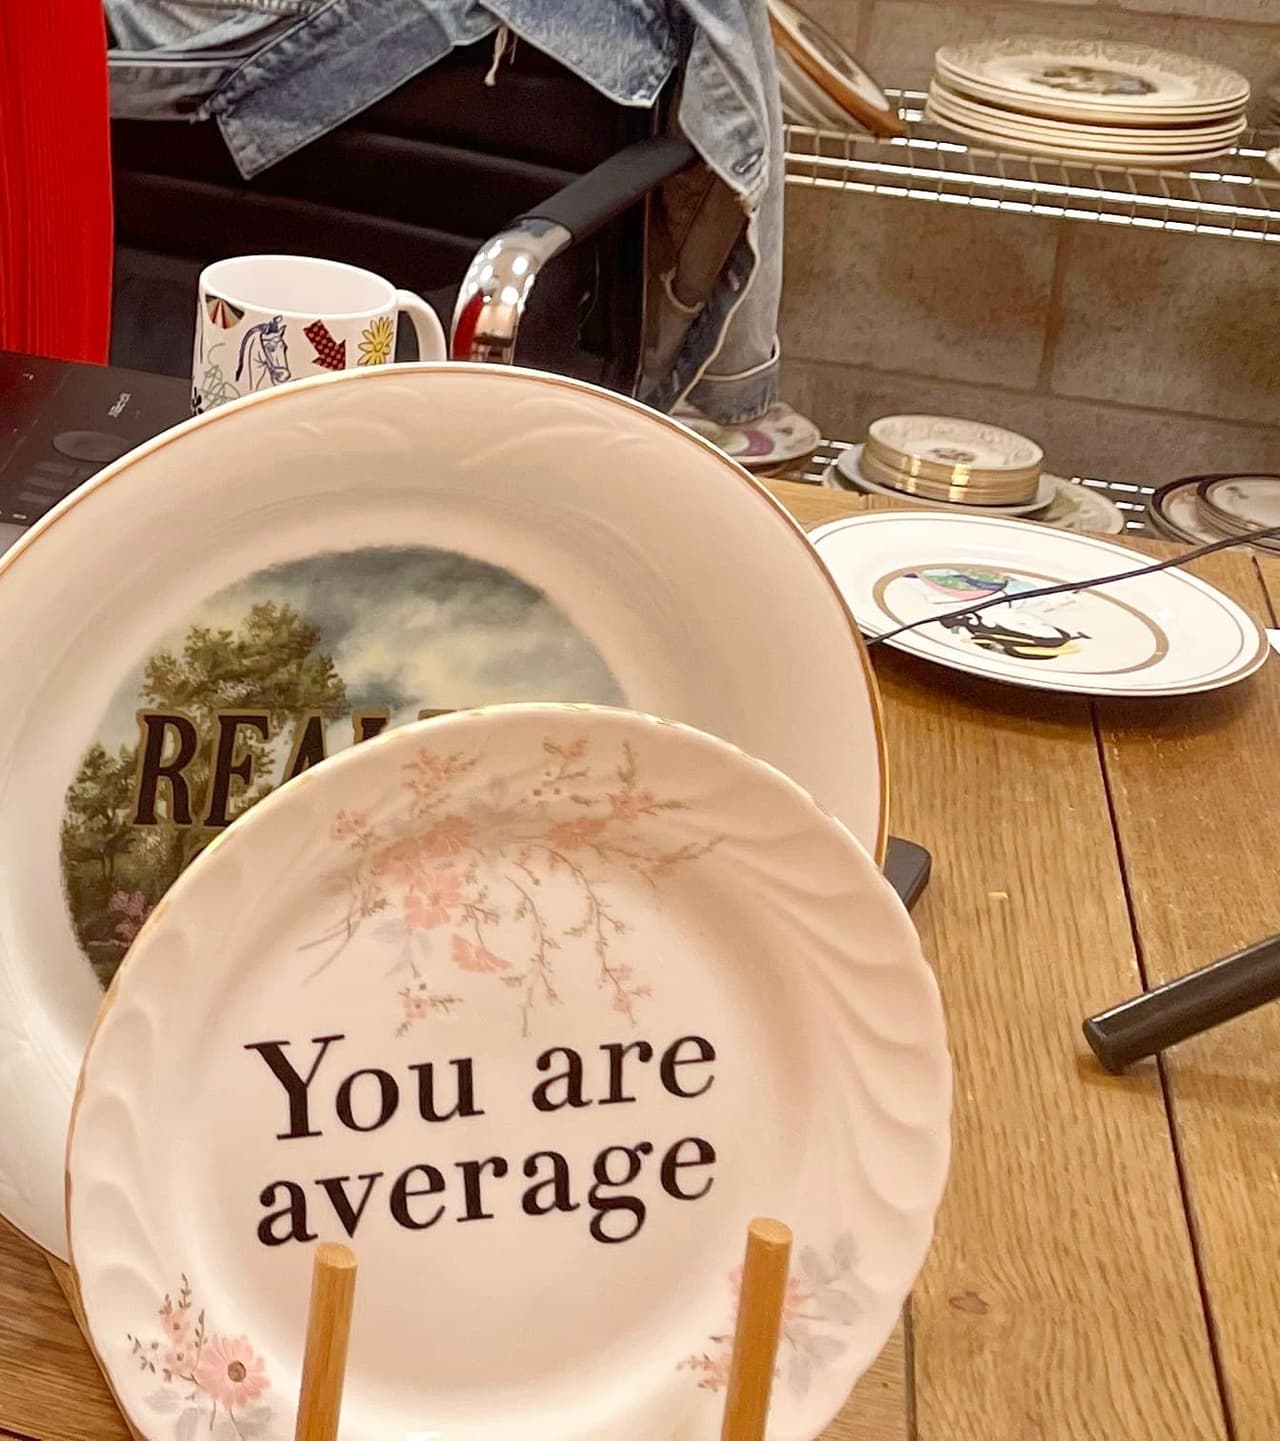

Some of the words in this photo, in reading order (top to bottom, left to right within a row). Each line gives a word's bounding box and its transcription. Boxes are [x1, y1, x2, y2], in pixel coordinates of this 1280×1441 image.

[244, 1034, 485, 1141] You
[530, 1031, 717, 1113] are
[256, 1133, 718, 1247] average
